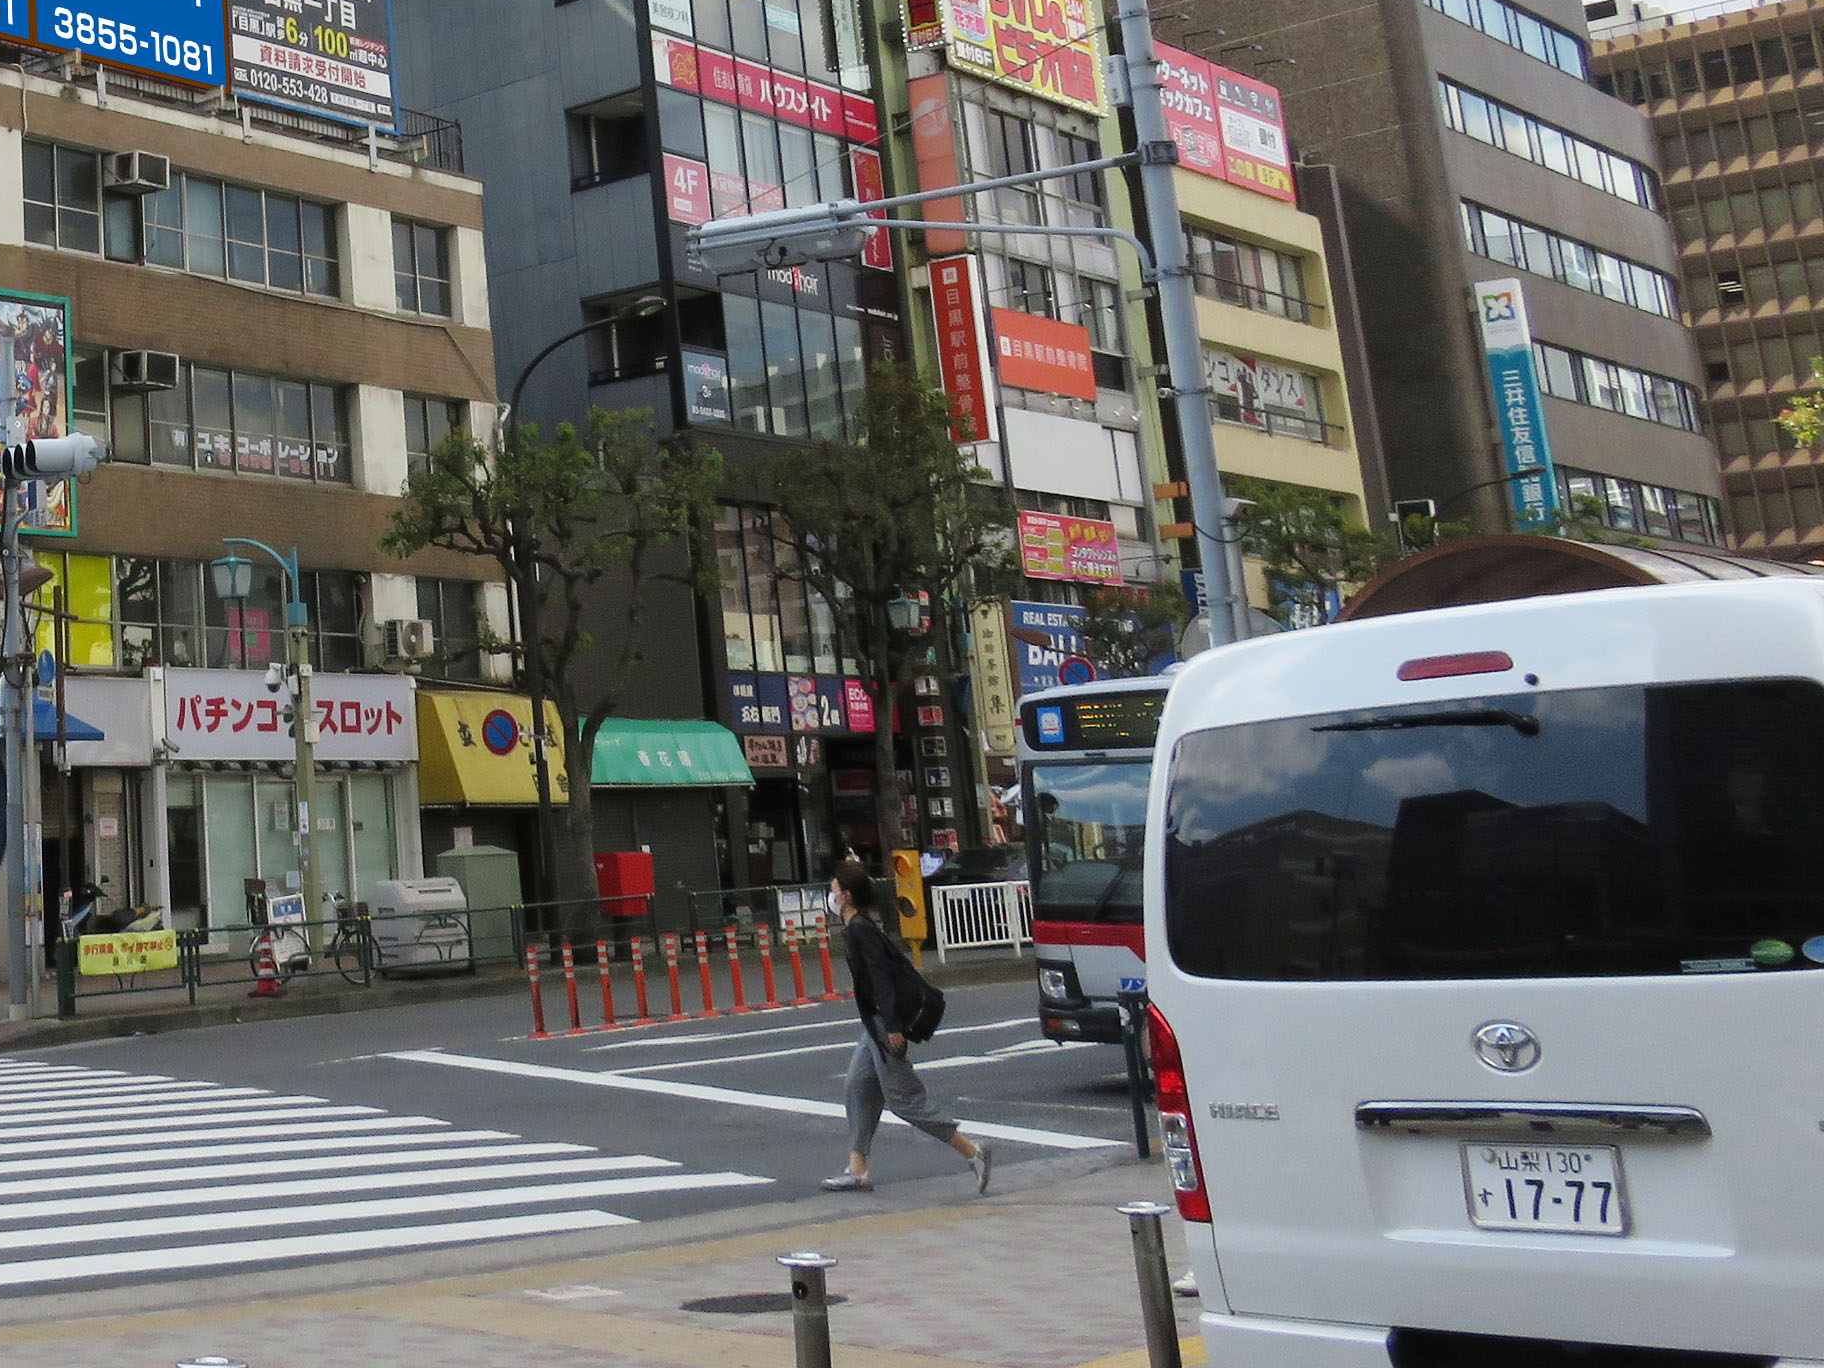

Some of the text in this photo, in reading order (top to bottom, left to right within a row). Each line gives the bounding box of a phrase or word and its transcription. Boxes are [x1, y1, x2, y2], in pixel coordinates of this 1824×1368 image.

[54, 7, 213, 75] 3855-1081
[314, 25, 348, 58] 100
[260, 45, 366, 89] 資料請求受付開始
[250, 69, 328, 104] 0120-553-428
[760, 79, 832, 122] ハウスメイト
[674, 167, 699, 195] 4F
[1013, 339, 1088, 372] 目黒駅前整骨院
[1023, 611, 1044, 625] REAL
[176, 695, 403, 736] パチンコ スロット
[1209, 1103, 1280, 1121] HIACE
[1499, 1151, 1582, 1173] 山梨 130
[1477, 1178, 1612, 1224] す 17-77
